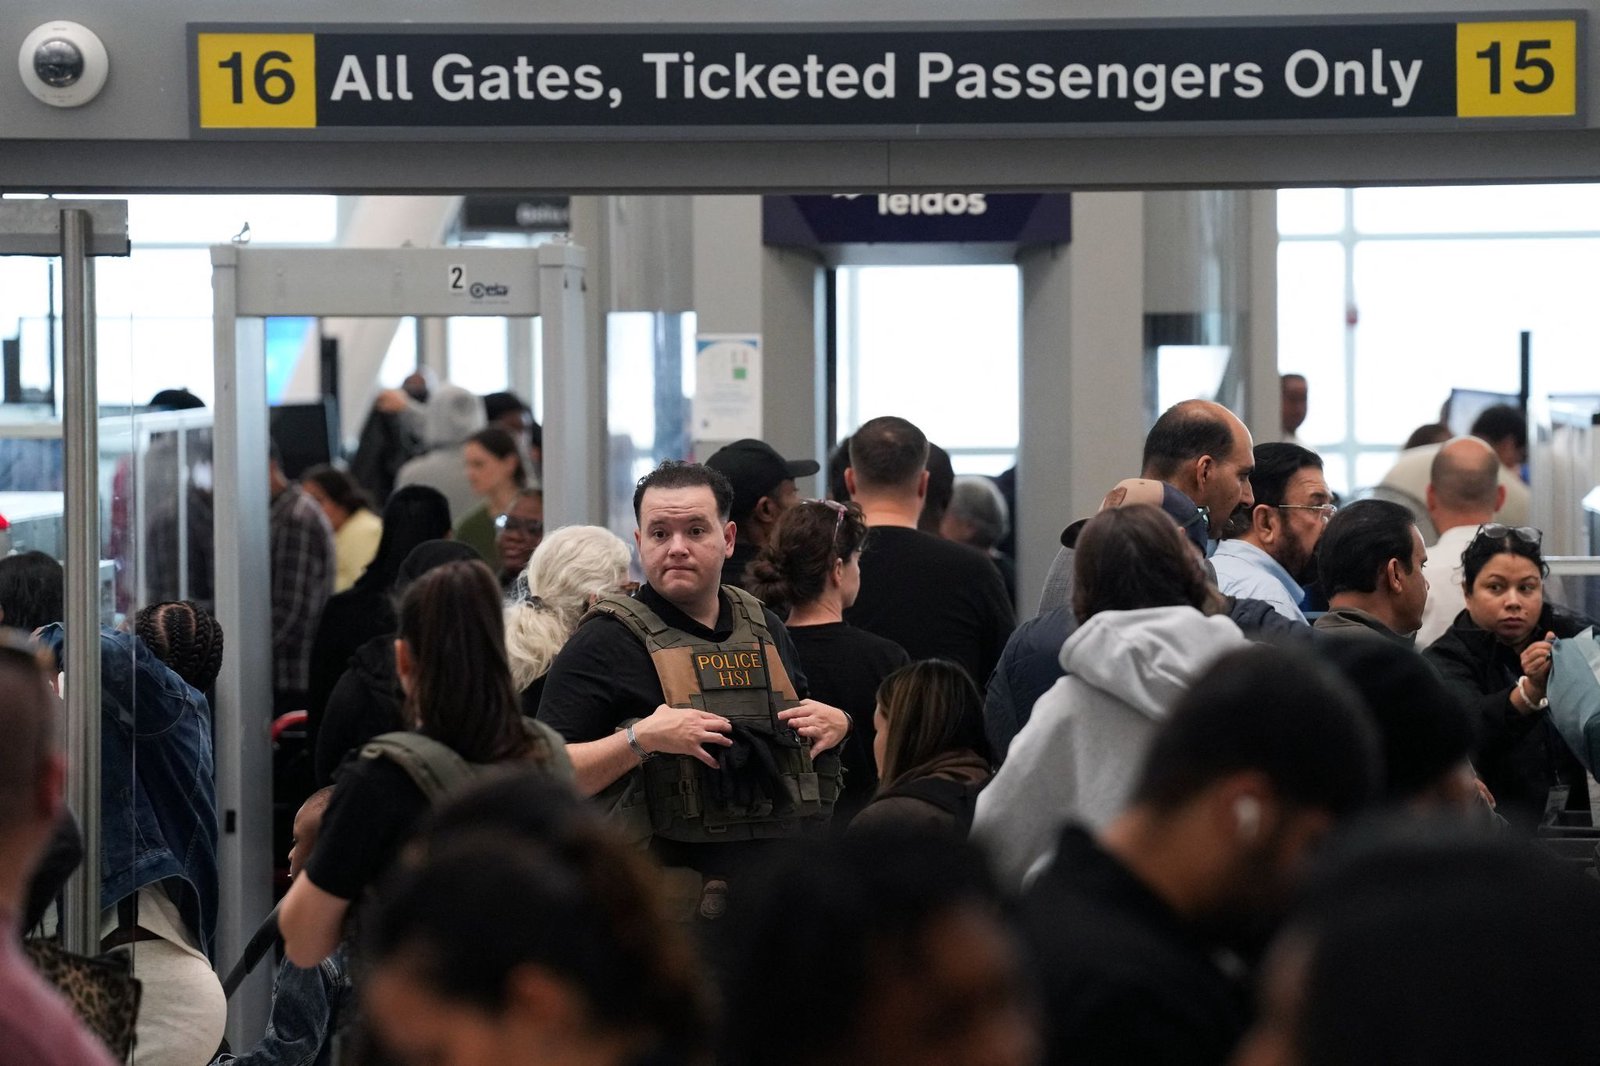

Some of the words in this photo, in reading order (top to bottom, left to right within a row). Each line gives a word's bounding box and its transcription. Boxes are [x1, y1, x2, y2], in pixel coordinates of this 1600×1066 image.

[218, 50, 296, 105] 16
[331, 54, 413, 101] All
[432, 53, 622, 109] Gates,
[643, 51, 895, 100] Ticketed
[919, 52, 1263, 112] Passengers
[1285, 48, 1422, 108] Only
[1475, 40, 1556, 95] 15
[451, 267, 464, 289] 2
[698, 653, 762, 670] POLICE
[719, 670, 752, 687] HSI
